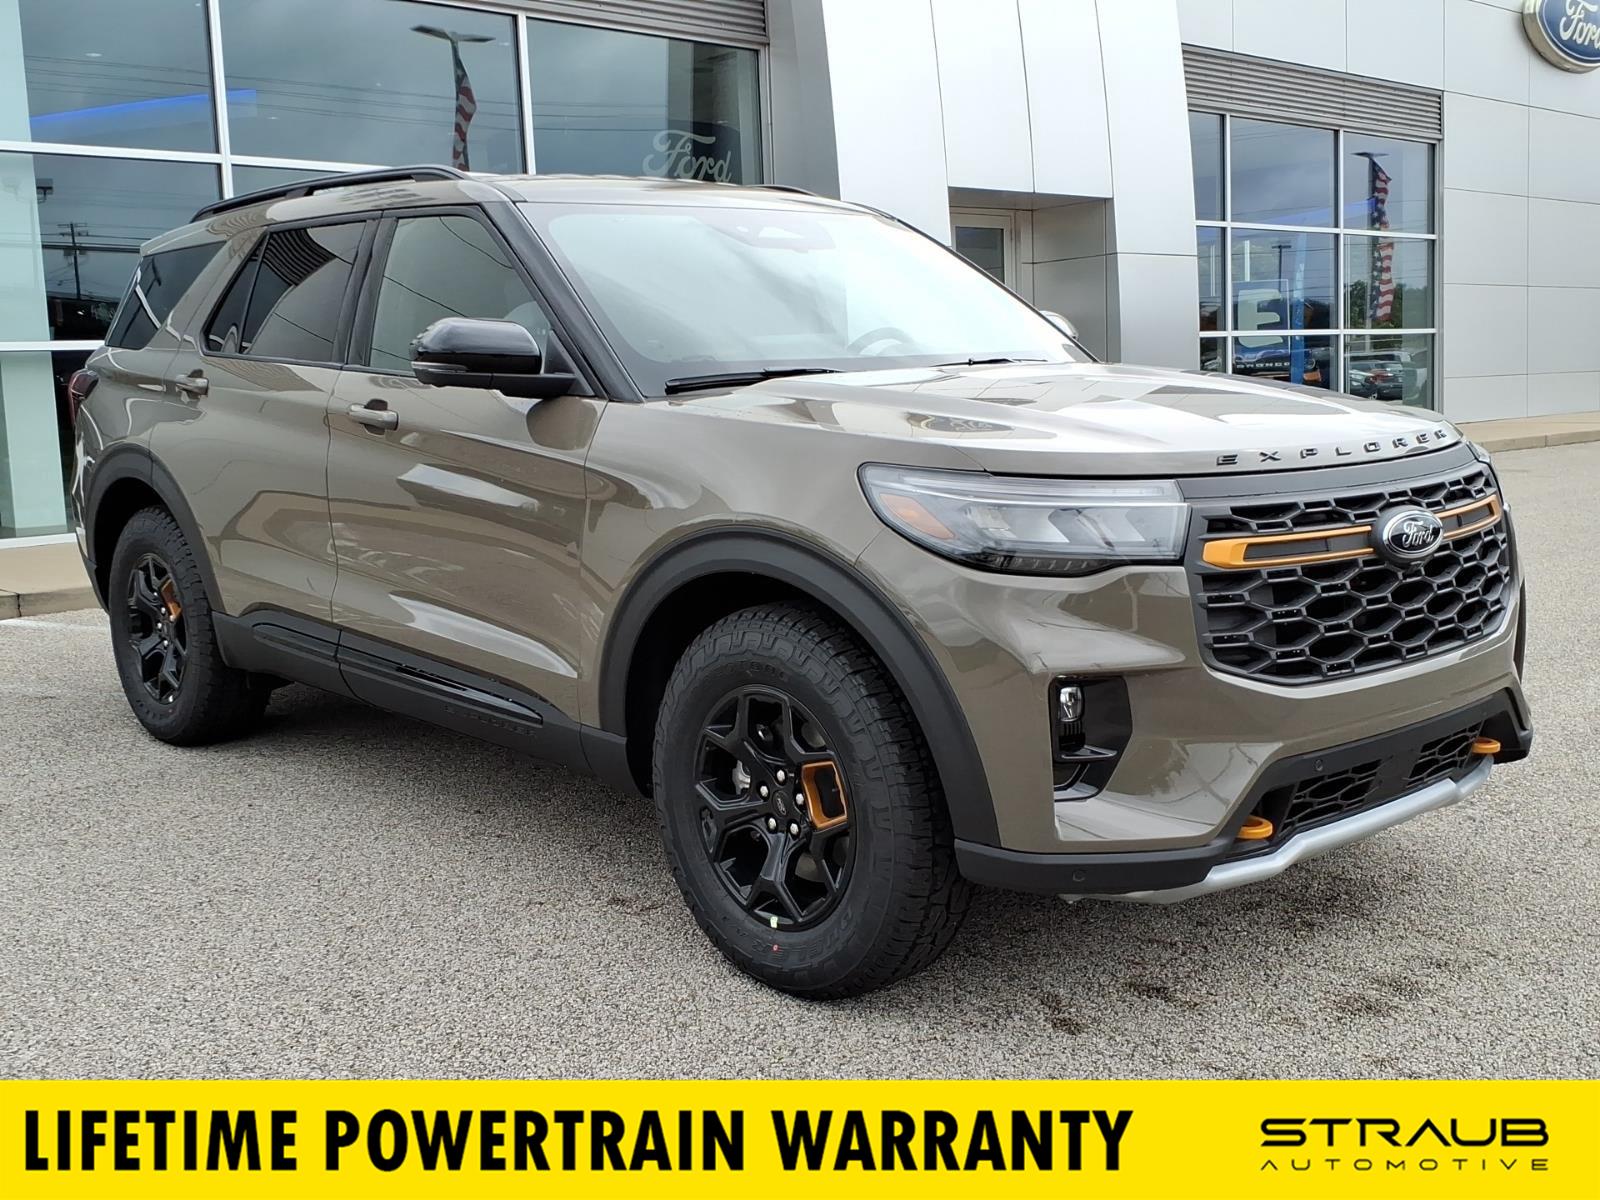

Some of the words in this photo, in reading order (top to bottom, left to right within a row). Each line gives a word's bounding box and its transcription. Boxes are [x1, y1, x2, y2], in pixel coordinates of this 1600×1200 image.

[642, 129, 732, 183] Ford
[1216, 428, 1448, 466] EXPLORER
[1402, 520, 1434, 548] Ford
